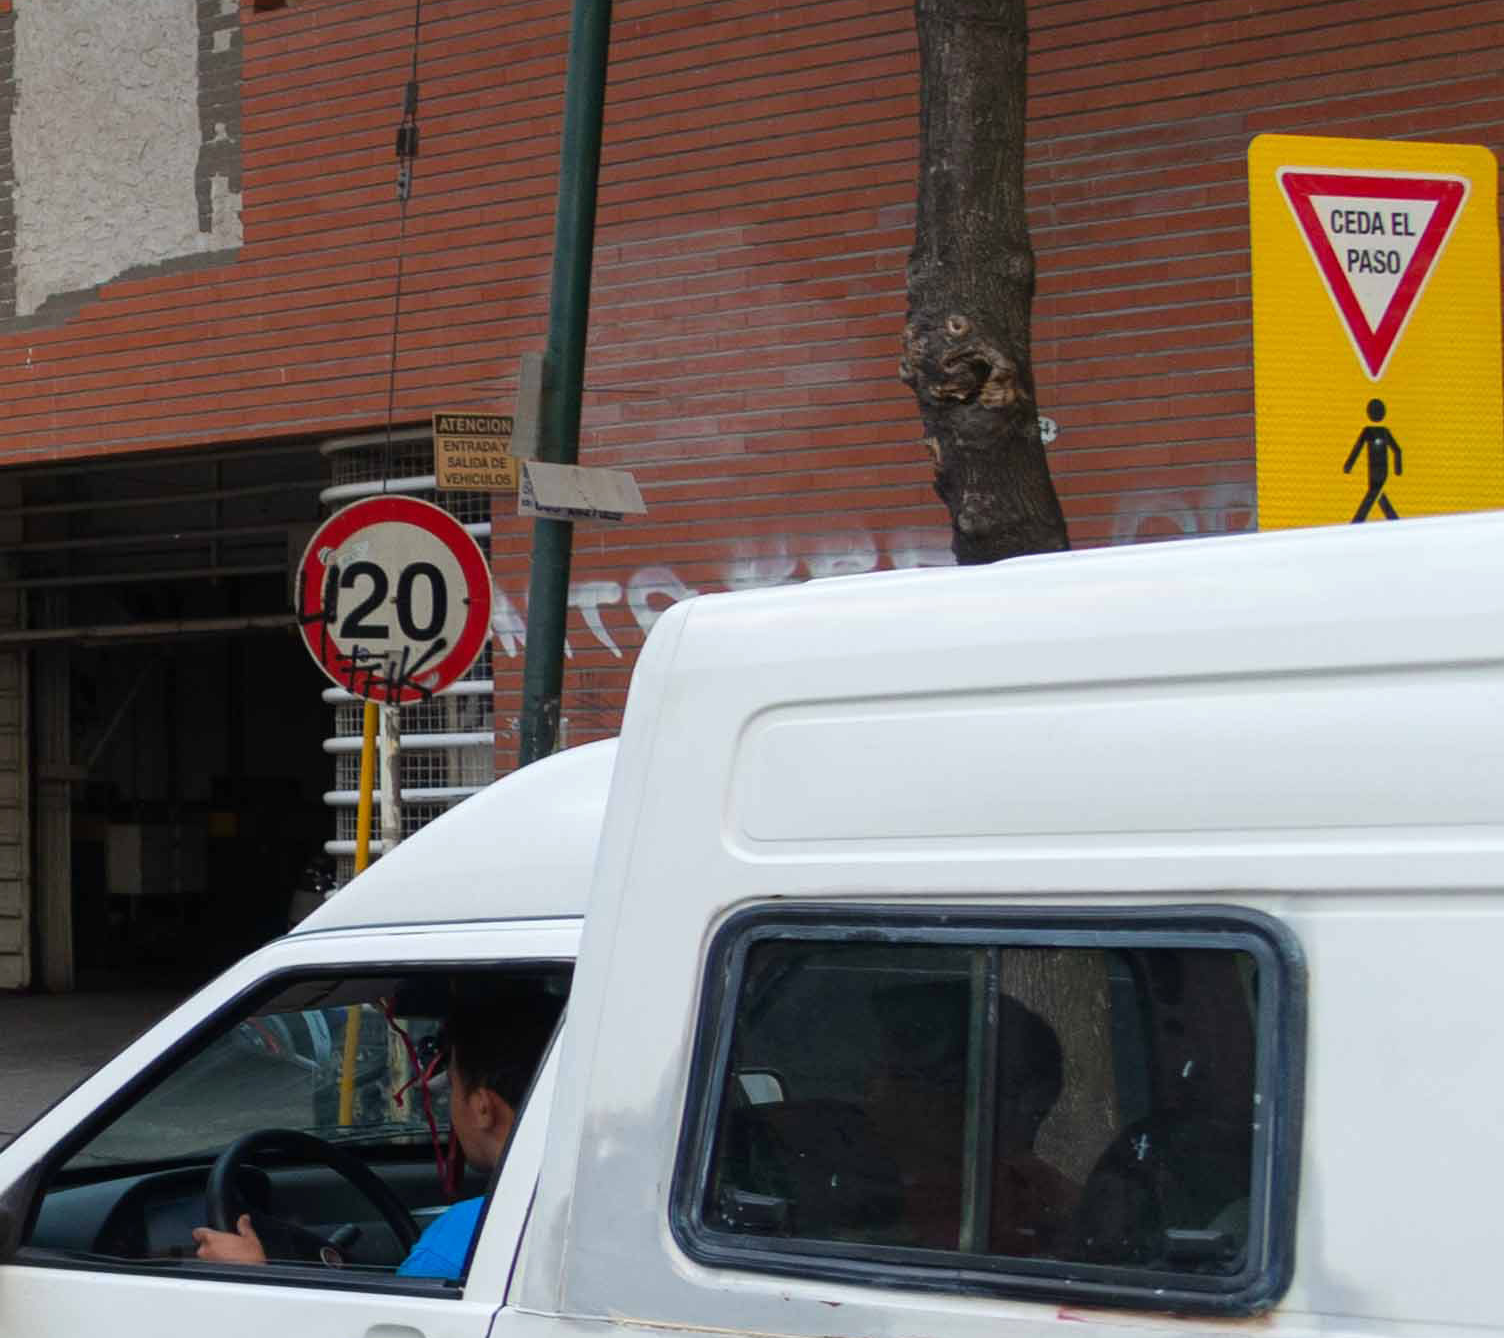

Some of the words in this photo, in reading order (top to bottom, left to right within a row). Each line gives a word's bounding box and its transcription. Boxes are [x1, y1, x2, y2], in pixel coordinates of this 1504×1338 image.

[1330, 209, 1386, 236] CEDA
[1391, 212, 1417, 237] EL
[1346, 248, 1402, 275] PASO
[438, 416, 513, 434] ATENCION
[443, 439, 498, 453] ENTRADA
[499, 441, 509, 452] Y
[447, 457, 490, 470] SALIDA
[492, 457, 508, 470] DE
[444, 473, 513, 486] VEHICULOS
[340, 560, 448, 642] 20
